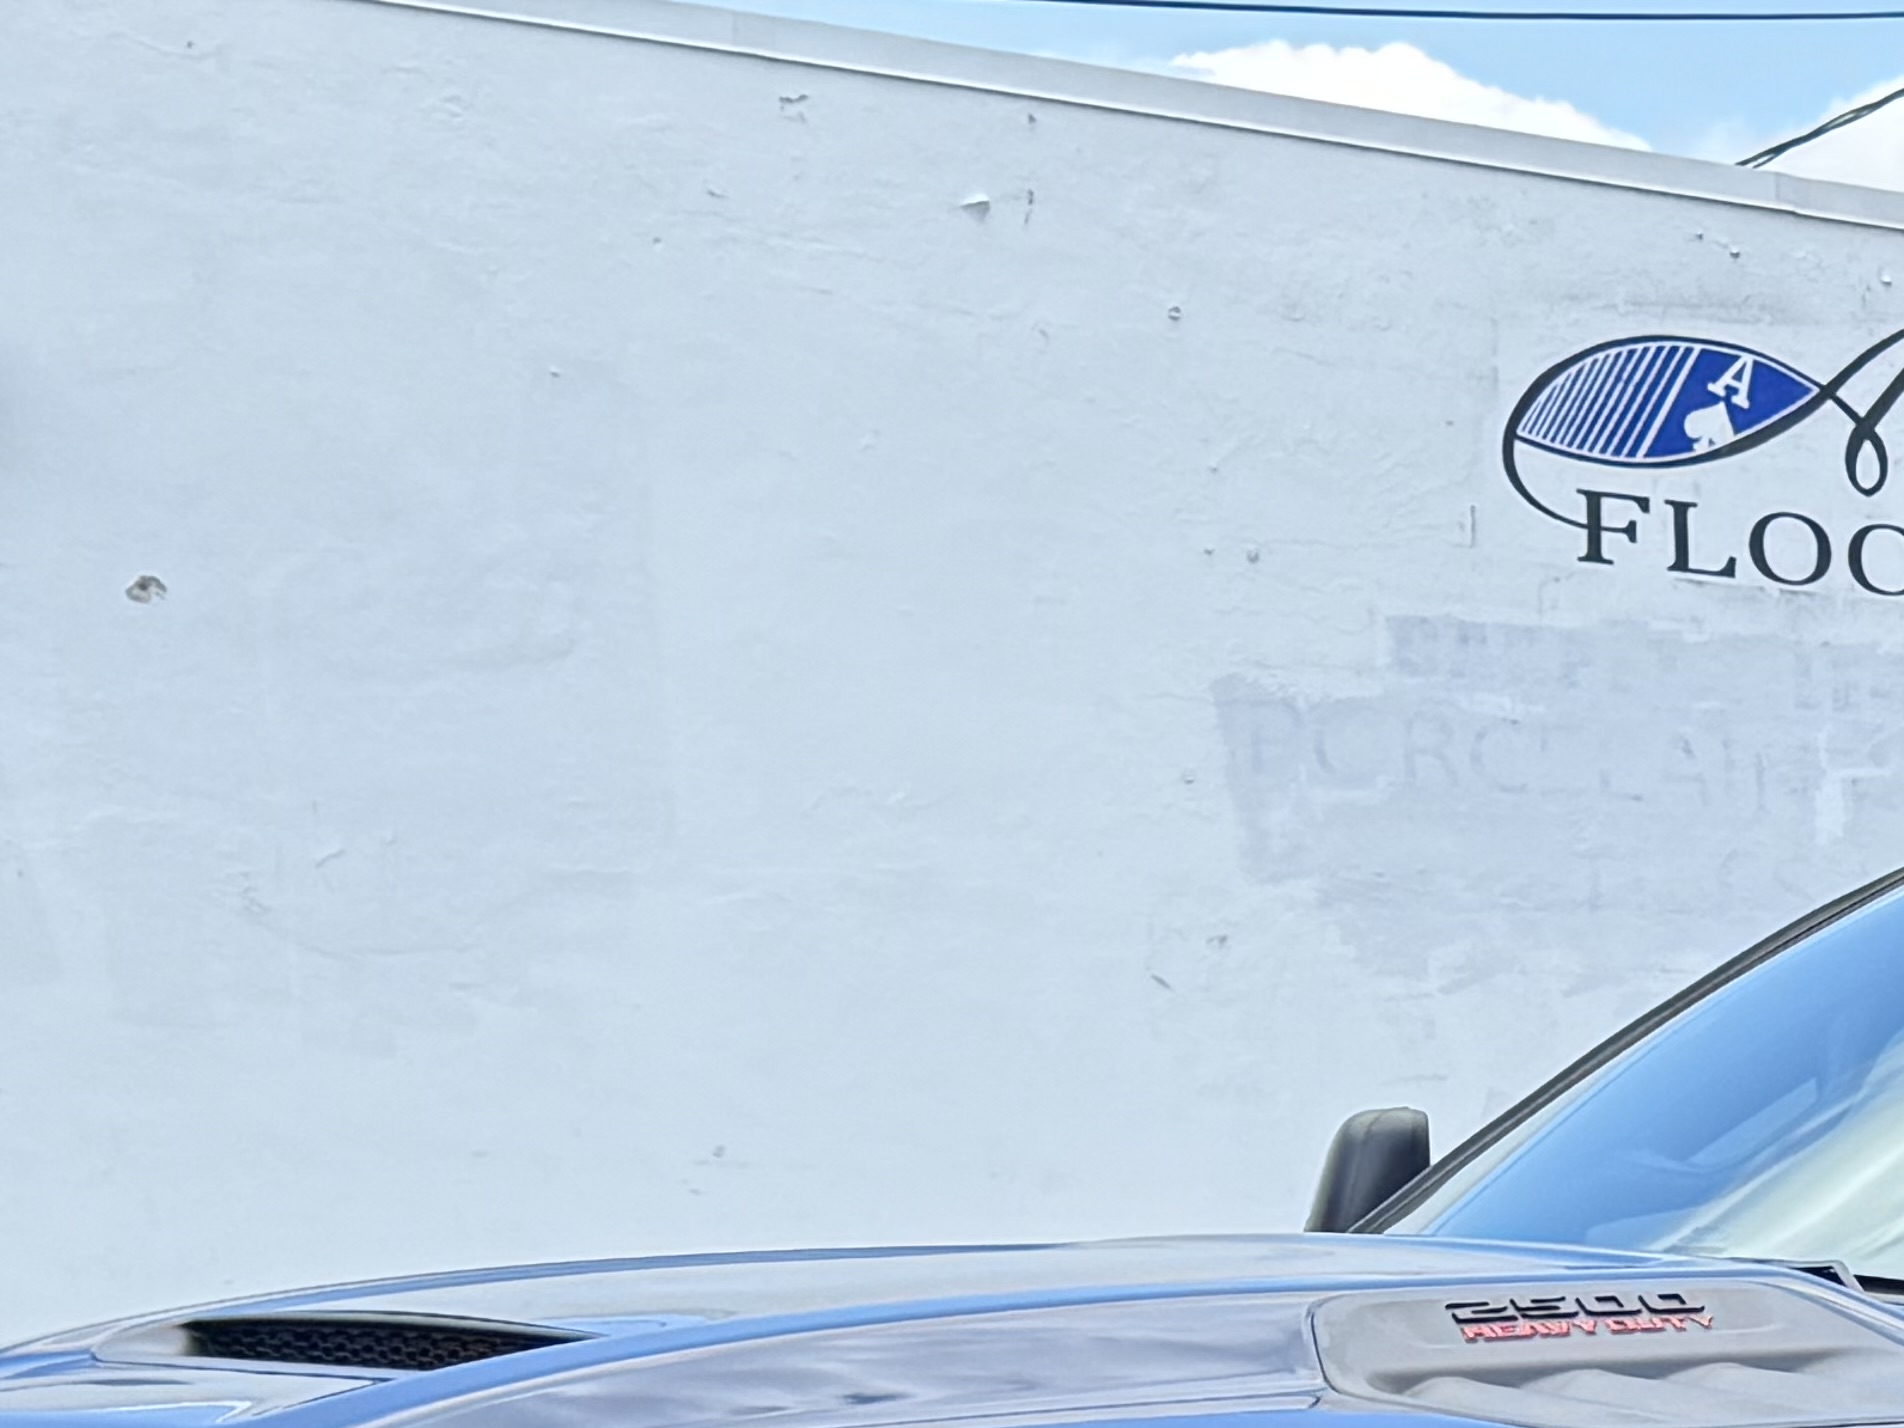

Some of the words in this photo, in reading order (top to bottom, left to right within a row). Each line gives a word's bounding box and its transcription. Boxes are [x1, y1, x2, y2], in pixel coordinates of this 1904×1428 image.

[1445, 1293, 1705, 1324] 2500
[1461, 1318, 1598, 1344] HEAVY
[1599, 1312, 1714, 1336] DUTY
